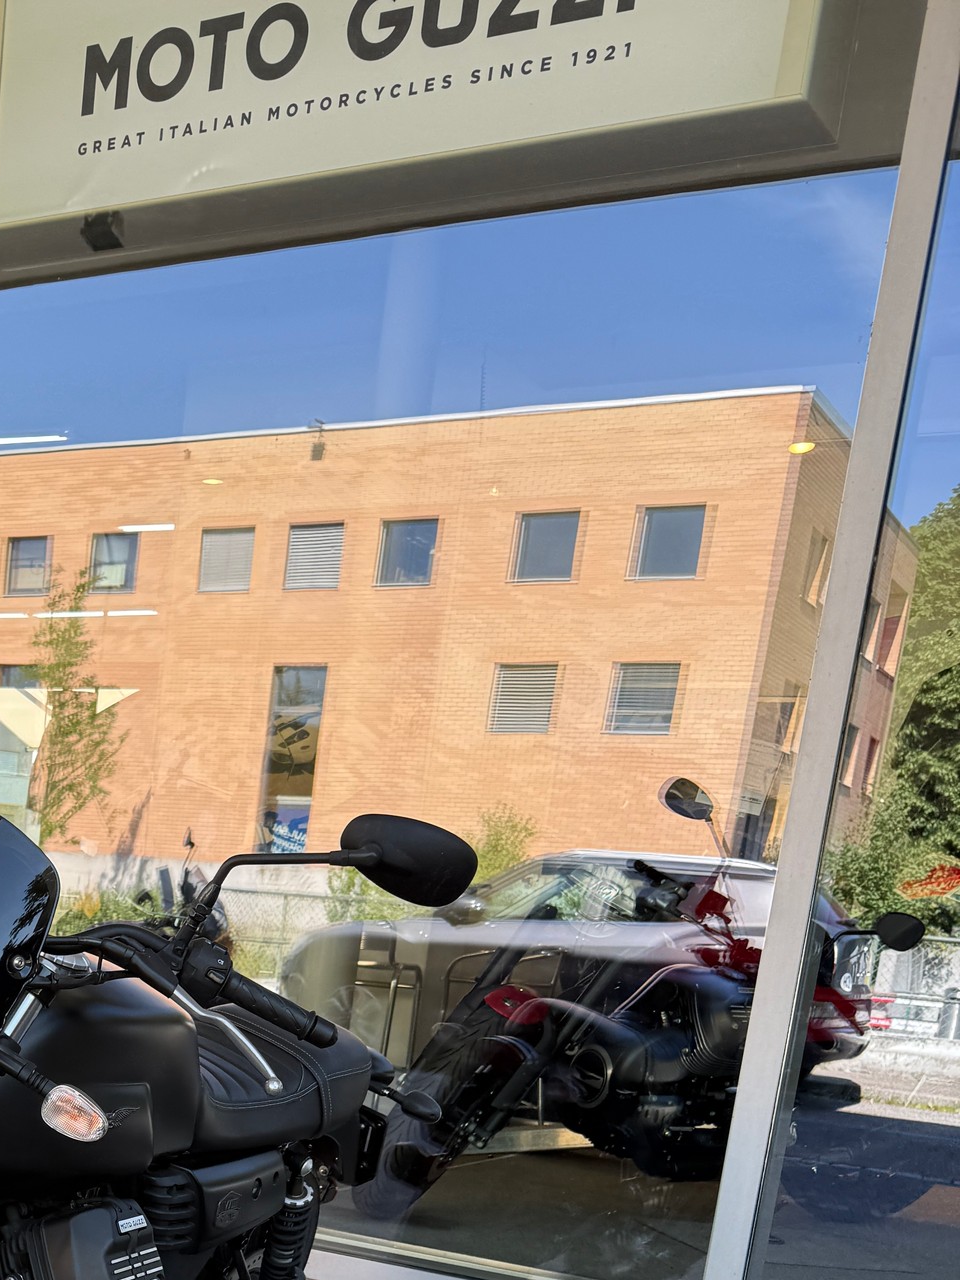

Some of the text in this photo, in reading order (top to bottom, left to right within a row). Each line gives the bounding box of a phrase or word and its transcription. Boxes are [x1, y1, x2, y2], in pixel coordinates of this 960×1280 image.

[77, 42, 632, 156] GREAT ITALIAN MOTORCYCLES SINCE 1921
[80, 0, 636, 117] MOTO GUZ
